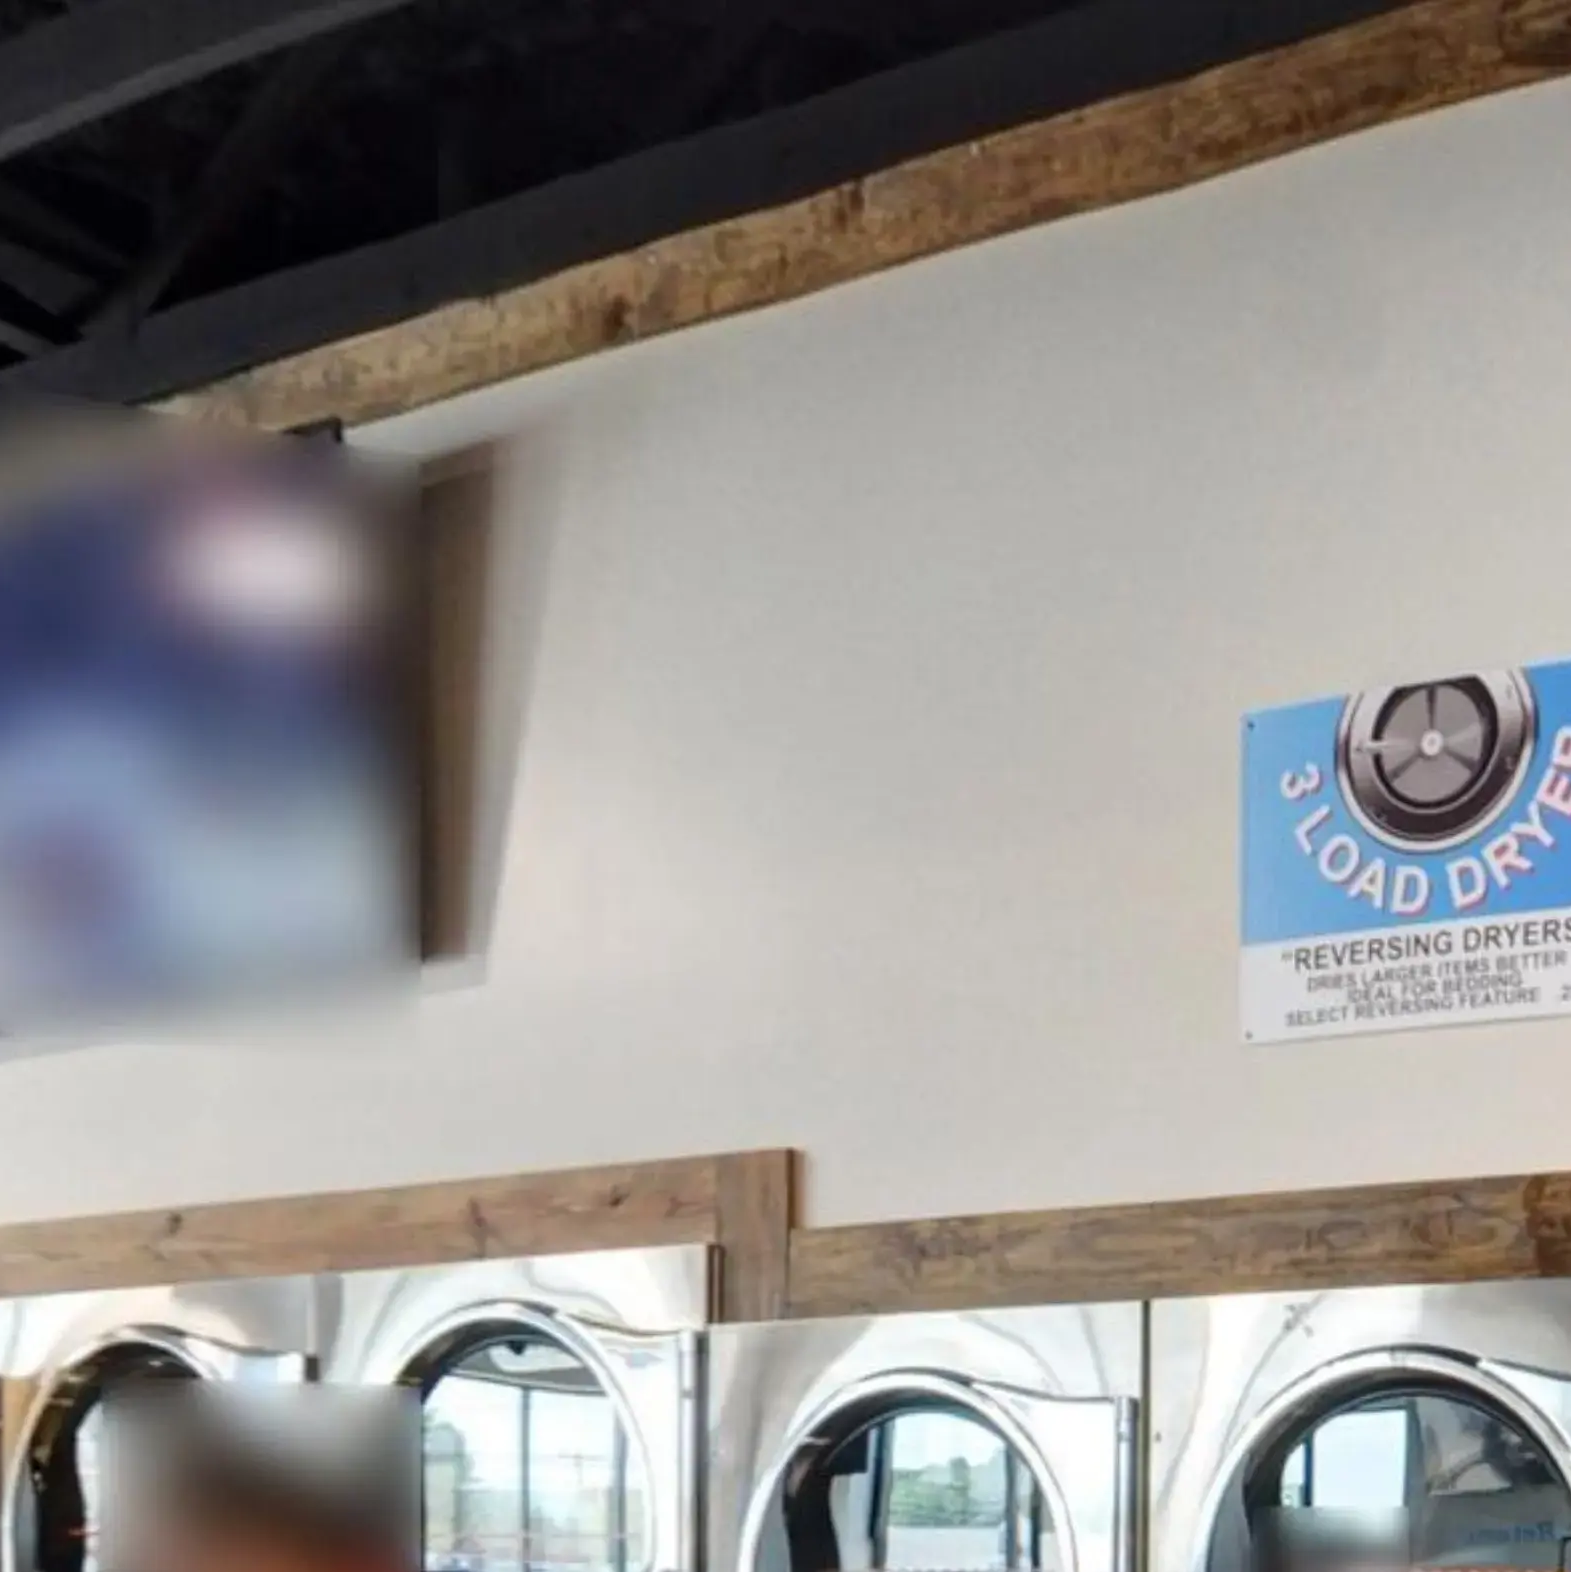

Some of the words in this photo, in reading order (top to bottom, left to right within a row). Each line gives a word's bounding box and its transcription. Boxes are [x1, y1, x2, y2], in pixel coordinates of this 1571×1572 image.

[1280, 761, 1321, 801] 3
[1294, 804, 1429, 917] LOAD
[1361, 963, 1430, 986] LARGER
[1437, 956, 1490, 977] ITEMS
[1496, 949, 1568, 970] BETTER
[1401, 979, 1437, 998] FOR
[1442, 968, 1524, 992] BEDDING
[1285, 1004, 1348, 1028] SELECT
[1354, 992, 1453, 1020] REVERSING
[1458, 985, 1542, 1009] FEATURE
